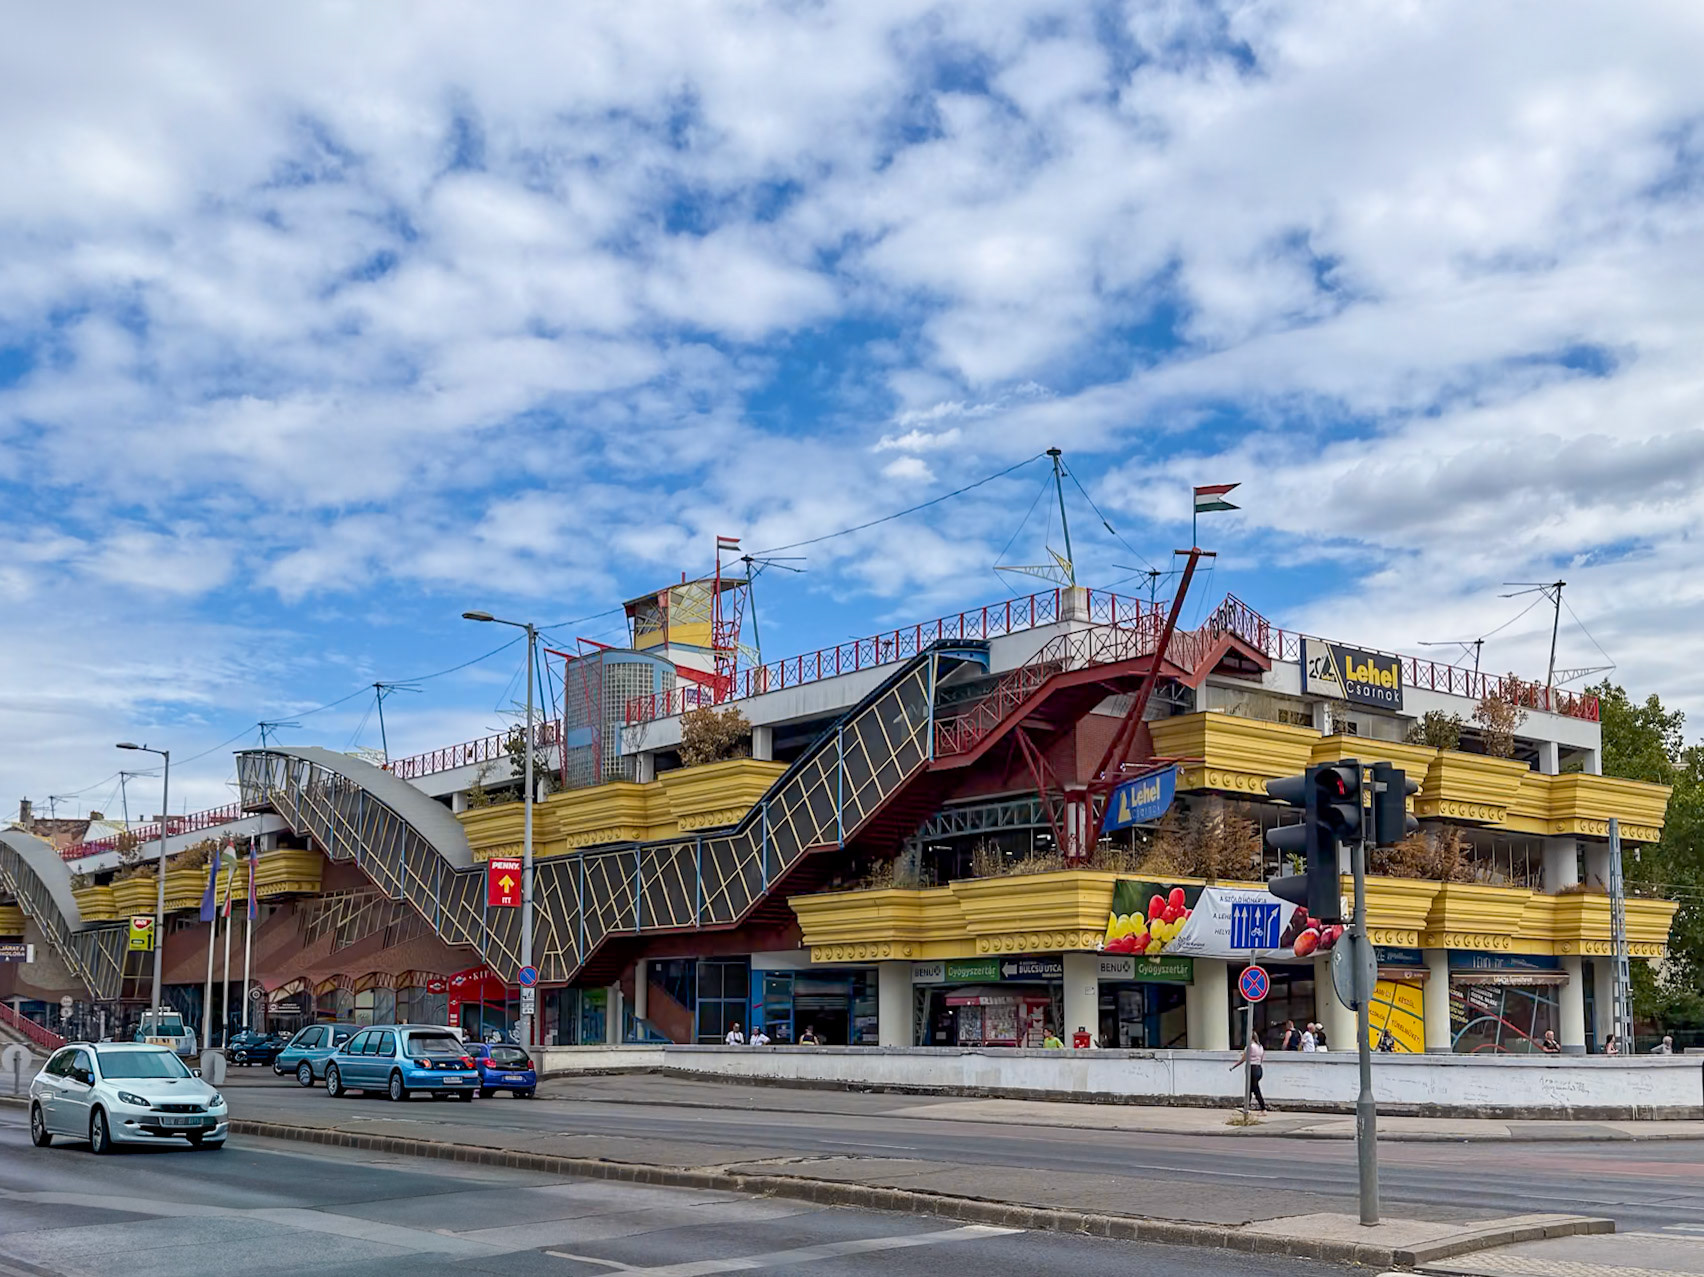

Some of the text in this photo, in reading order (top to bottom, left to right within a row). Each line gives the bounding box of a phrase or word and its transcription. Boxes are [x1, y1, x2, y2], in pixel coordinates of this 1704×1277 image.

[1345, 656, 1399, 690] Lehel
[1346, 680, 1400, 703] Csarnok
[1131, 777, 1160, 807] Lehel
[501, 896, 512, 904] ITT
[914, 967, 934, 977] BENU
[948, 964, 996, 978] Gyógyszertár
[1044, 963, 1062, 973] UTCA
[1100, 962, 1122, 972] BENU
[1138, 963, 1189, 976] Gyógyszertár
